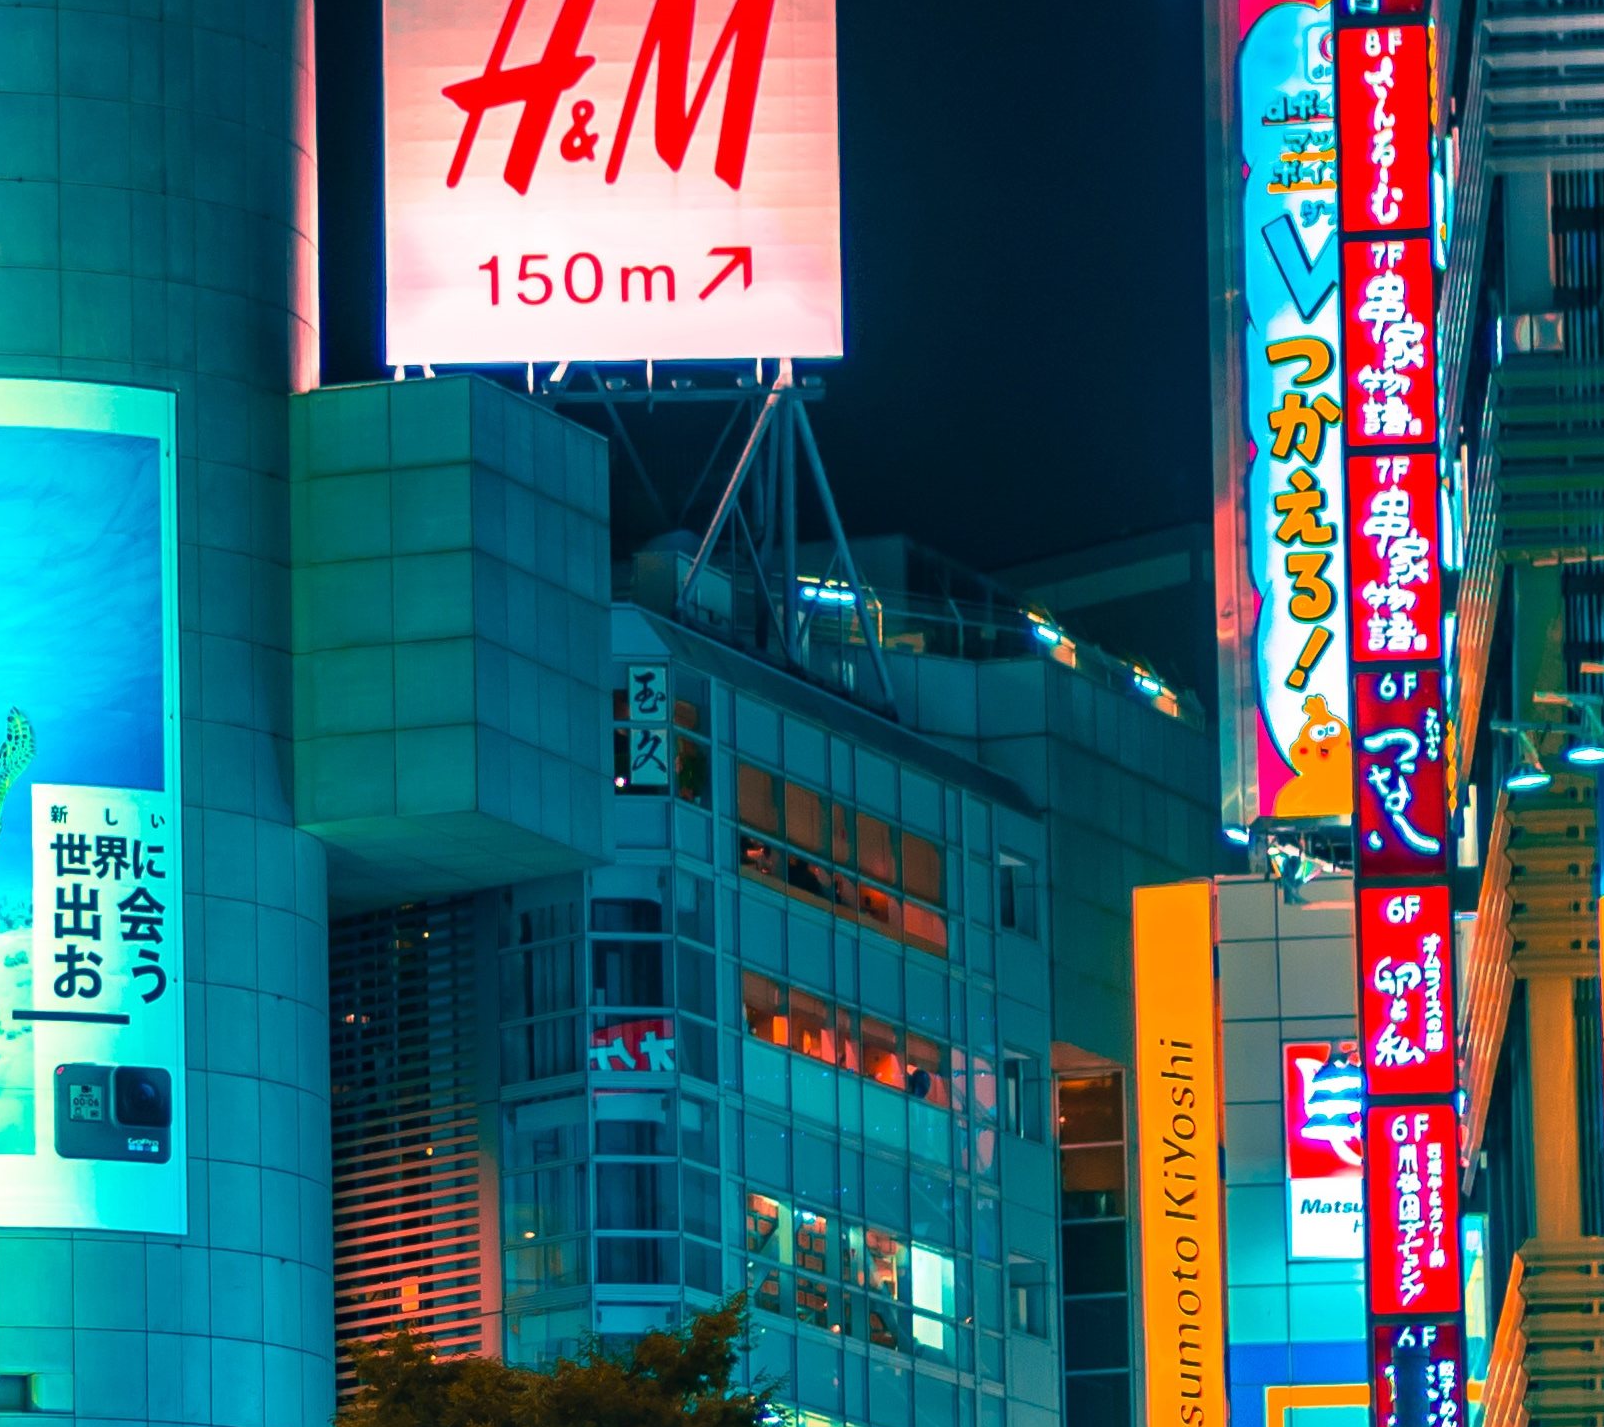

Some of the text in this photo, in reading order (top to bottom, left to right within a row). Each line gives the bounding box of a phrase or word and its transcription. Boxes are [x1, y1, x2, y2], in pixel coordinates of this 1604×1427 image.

[1364, 28, 1403, 57] 8F
[1371, 242, 1404, 269] 7F
[1376, 457, 1410, 484] 7F
[1379, 674, 1418, 701] 6F
[49, 802, 168, 830] 新しい
[49, 831, 167, 884] 世界に
[55, 884, 167, 946] 出会
[1386, 894, 1421, 924] 6F
[53, 949, 168, 1006] おう
[1390, 1114, 1430, 1143] 6F
